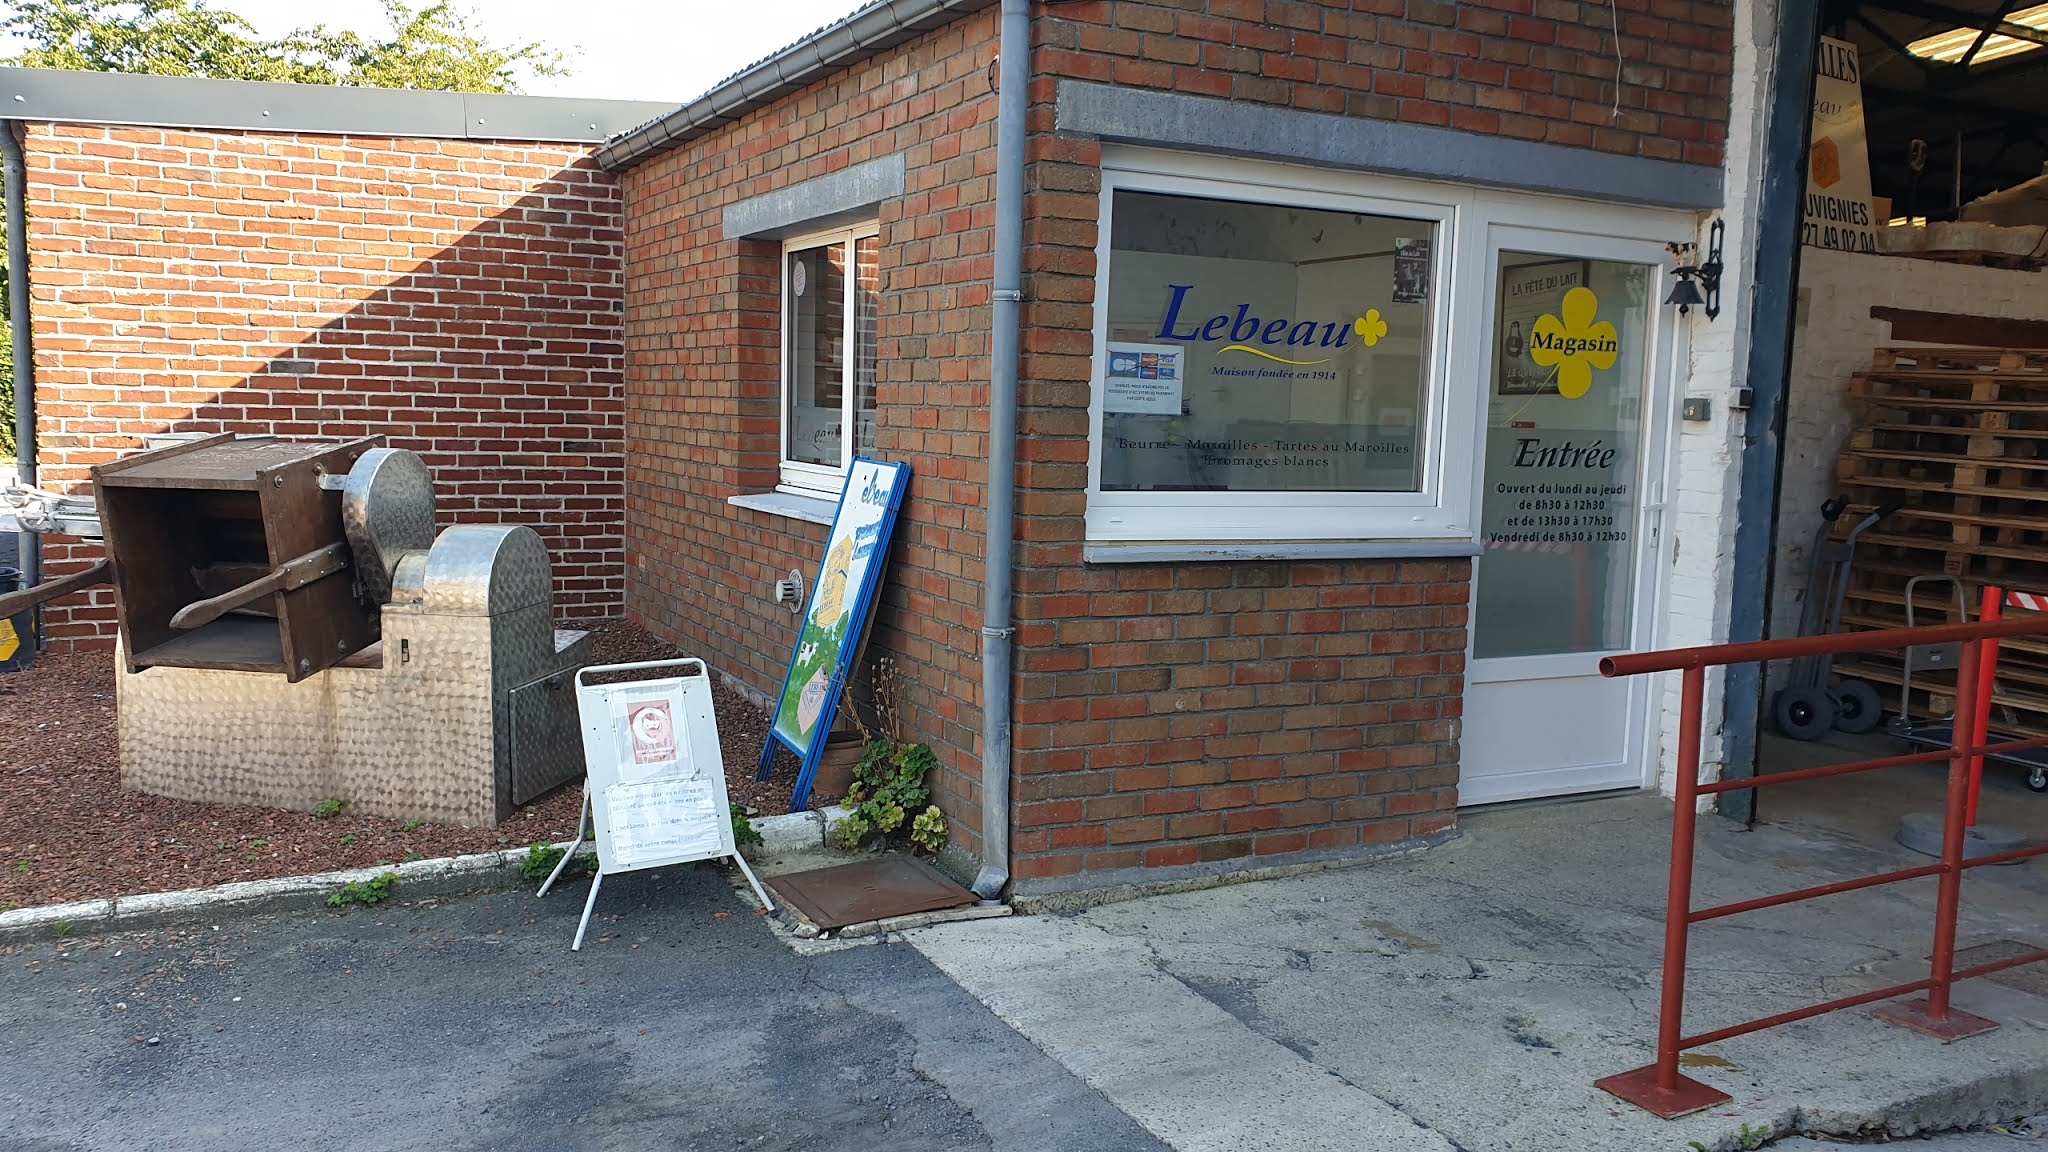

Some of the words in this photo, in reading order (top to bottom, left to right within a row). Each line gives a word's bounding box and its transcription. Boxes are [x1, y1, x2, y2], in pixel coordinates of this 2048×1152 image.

[1804, 222, 1818, 247] 27
[1824, 226, 1839, 248] 49
[1842, 229, 1857, 252] 02
[1861, 232, 1876, 254] 04
[1512, 283, 1523, 296] LA
[1546, 275, 1558, 289] DU
[1560, 272, 1577, 287] LAIT
[1155, 284, 1352, 348] Lebeau
[1531, 331, 1618, 356] Magasin
[1211, 366, 1255, 377] Maison
[1257, 368, 1294, 379] fondée
[1312, 371, 1336, 380] 1914
[1119, 438, 1170, 449] Beurre
[1274, 440, 1317, 452] Tartes
[1322, 442, 1339, 452] au
[1345, 441, 1409, 454] Maroilles
[1514, 438, 1616, 469] Entrée
[1284, 455, 1329, 467] blancs
[1498, 483, 1536, 494] Ouvert
[1538, 483, 1552, 494] du
[1555, 483, 1582, 494] lundi
[1585, 485, 1597, 494] au
[1599, 484, 1626, 497] jeudi
[1519, 499, 1532, 510] de
[1535, 500, 1561, 510] 8h30
[1564, 500, 1570, 510] à
[1574, 500, 1605, 510] 12h30
[1507, 516, 1518, 526] et
[1521, 516, 1535, 526] de
[1539, 516, 1570, 526] 13h30
[1573, 516, 1579, 526] à
[1583, 516, 1613, 526] 17h30
[1490, 531, 1540, 543] Vendredi
[1543, 531, 1556, 542] de
[1559, 531, 1584, 541] 8h30
[1587, 531, 1593, 541] à
[1596, 531, 1627, 541] 12h30
